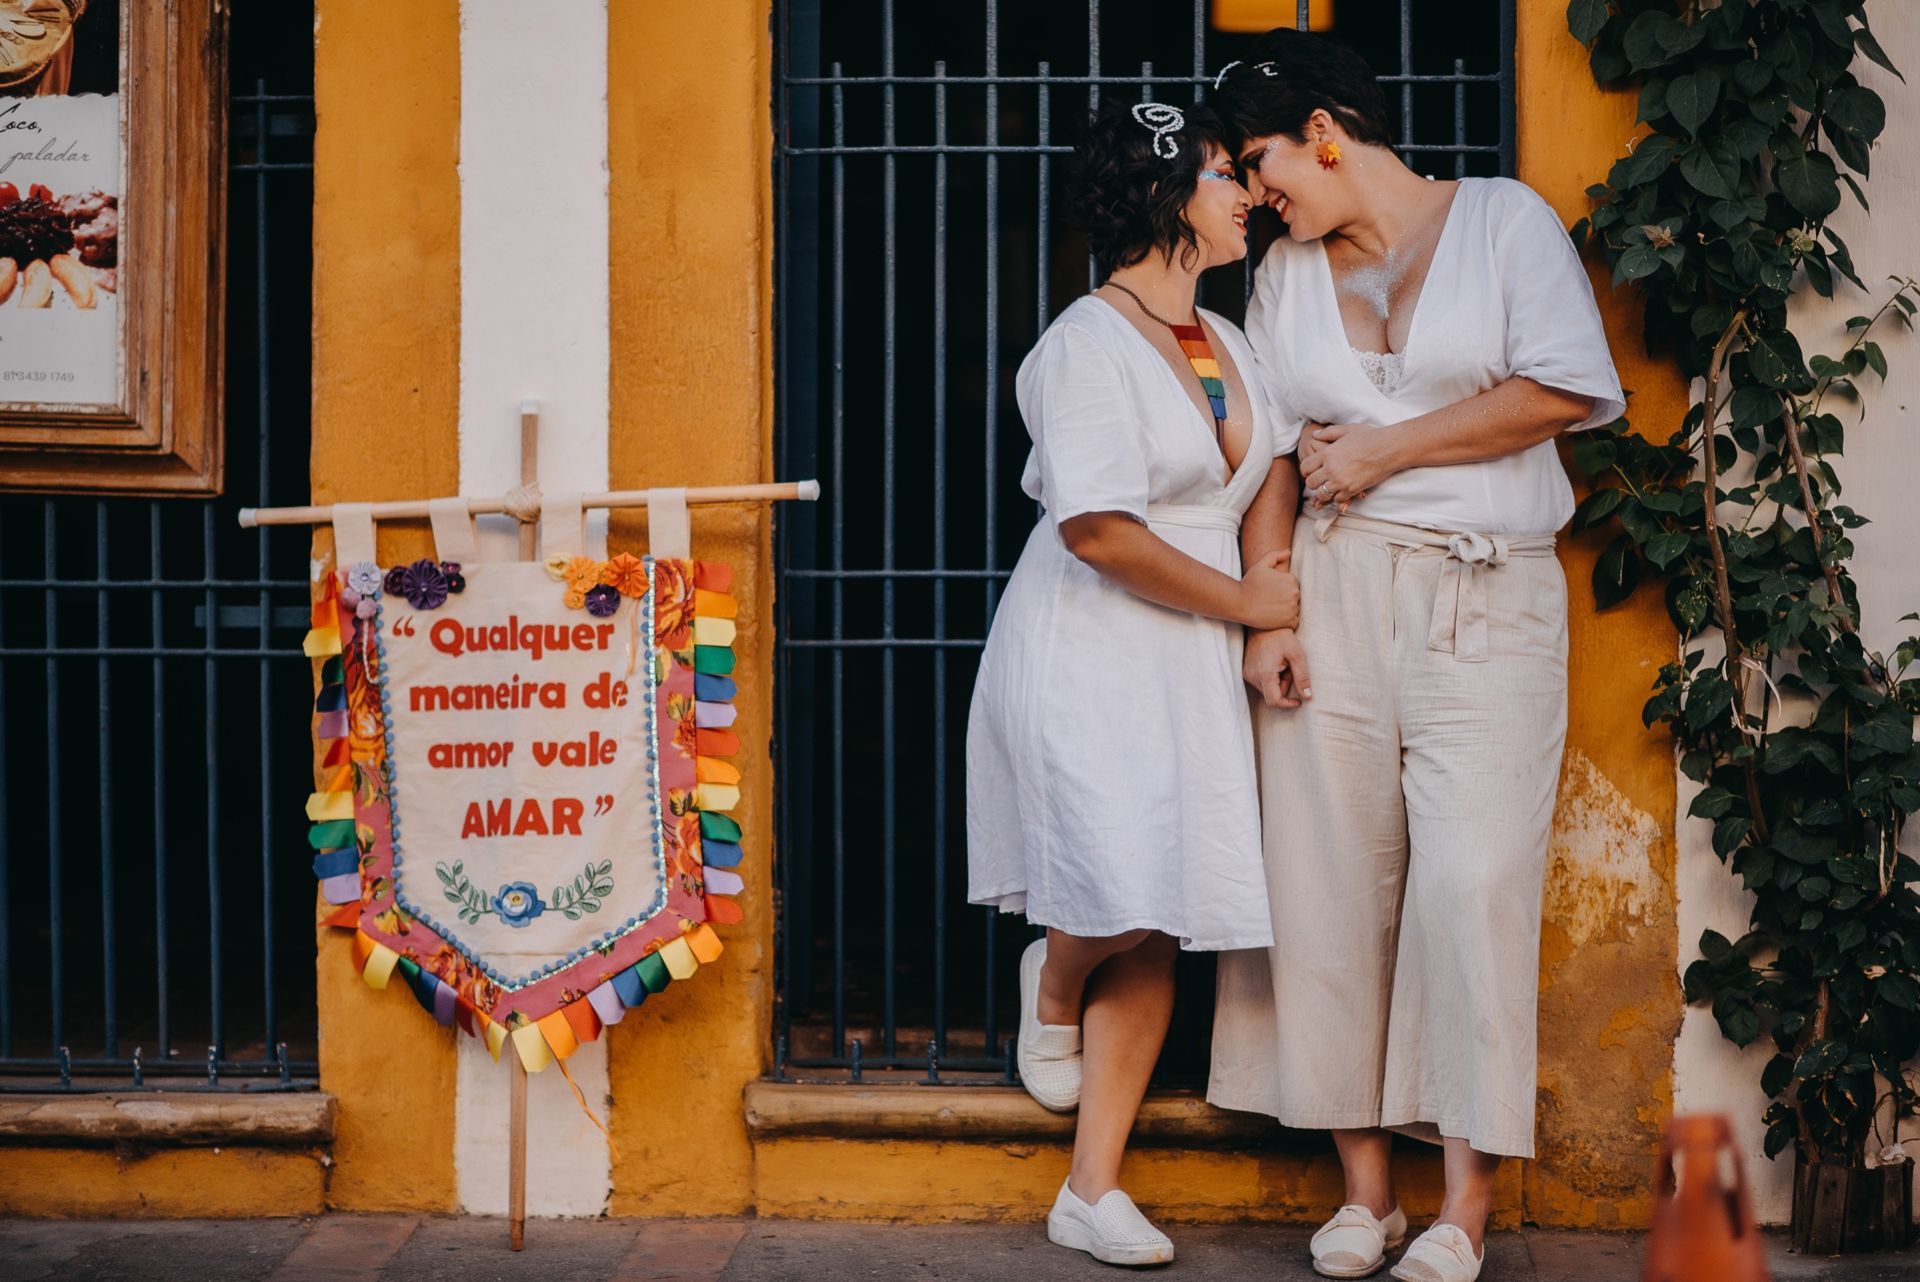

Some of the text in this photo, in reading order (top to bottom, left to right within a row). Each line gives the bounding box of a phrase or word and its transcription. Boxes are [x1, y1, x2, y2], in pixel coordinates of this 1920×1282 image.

[0, 137, 91, 174] paladar
[409, 672, 629, 712] maneira de
[428, 731, 618, 769] amor vale
